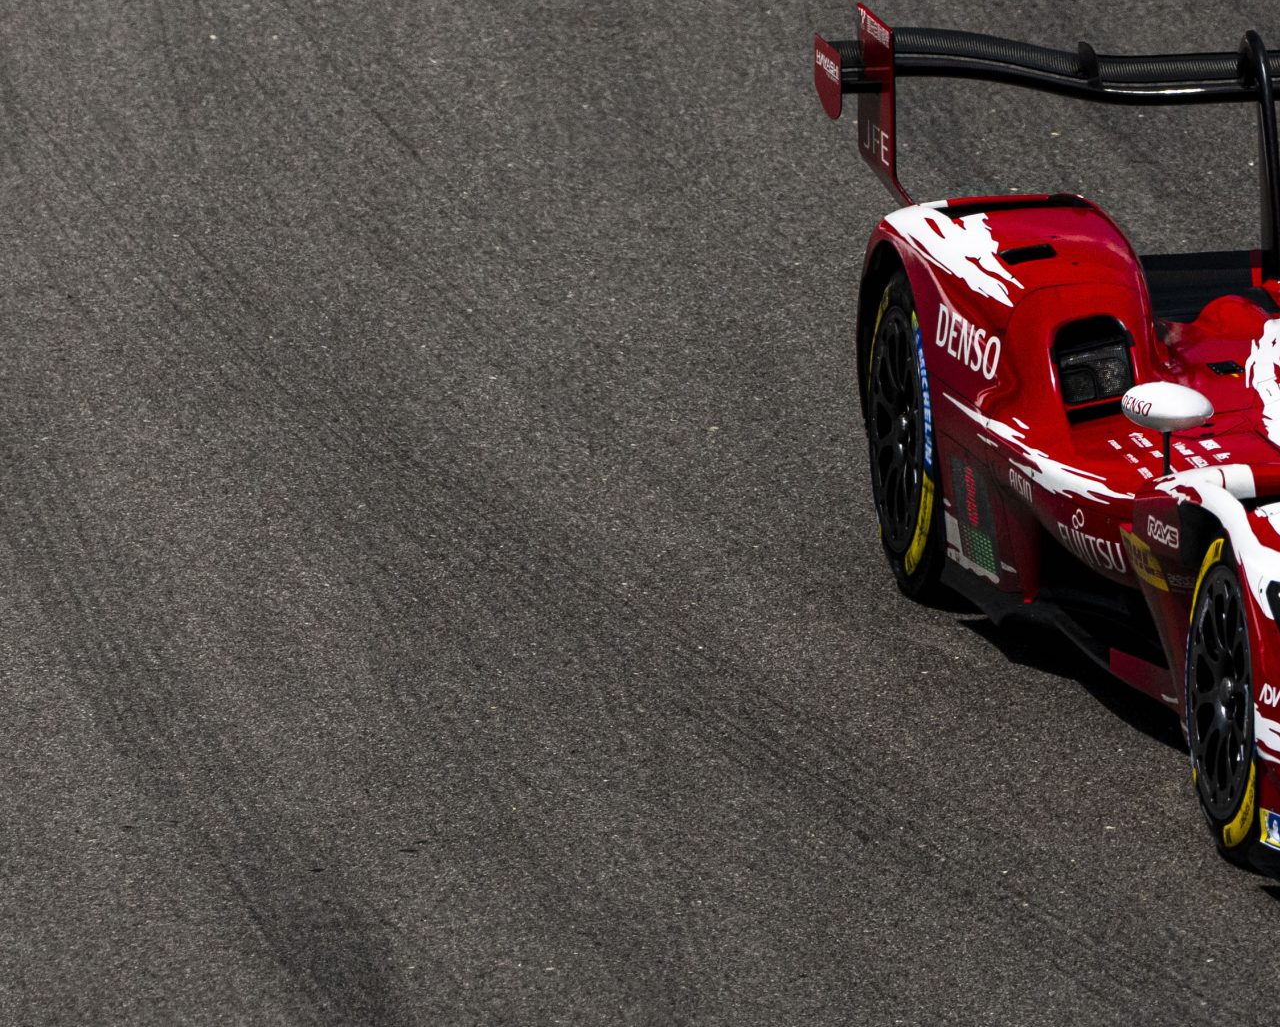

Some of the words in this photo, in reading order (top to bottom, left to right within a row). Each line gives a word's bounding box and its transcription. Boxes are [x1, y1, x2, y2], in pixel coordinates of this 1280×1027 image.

[863, 119, 890, 166] JFE
[935, 302, 1001, 380] DENSO
[917, 347, 933, 466] MICHELIN
[1123, 394, 1153, 417] DENSO
[1057, 521, 1127, 573] FUJITSU
[1147, 514, 1180, 549] RAYS
